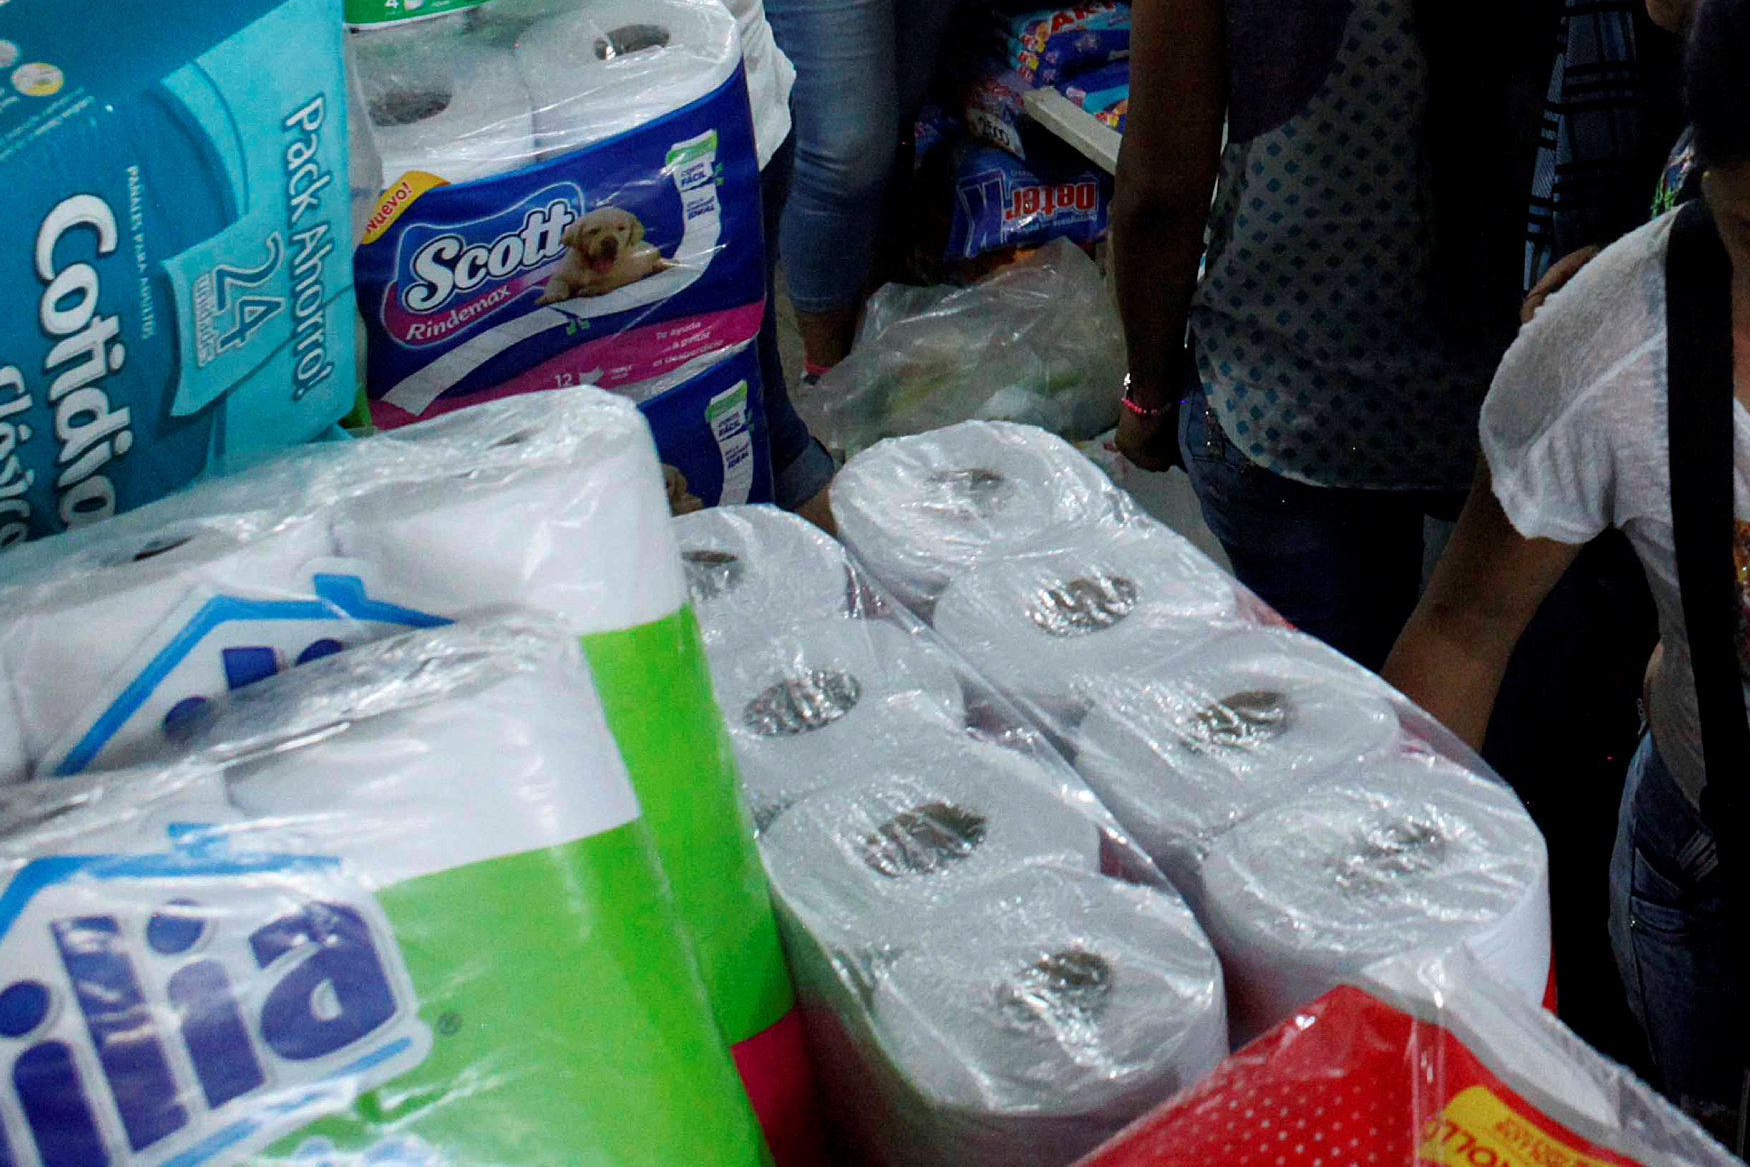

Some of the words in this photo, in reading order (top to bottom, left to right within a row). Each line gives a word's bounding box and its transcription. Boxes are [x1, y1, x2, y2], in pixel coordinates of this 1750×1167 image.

[283, 95, 336, 229] Pack
[215, 232, 286, 352] 24
[286, 229, 335, 403] Ahorro!
[405, 200, 577, 315] Scott
[405, 282, 512, 343] Rindemax
[35, 193, 134, 530] Cotidia
